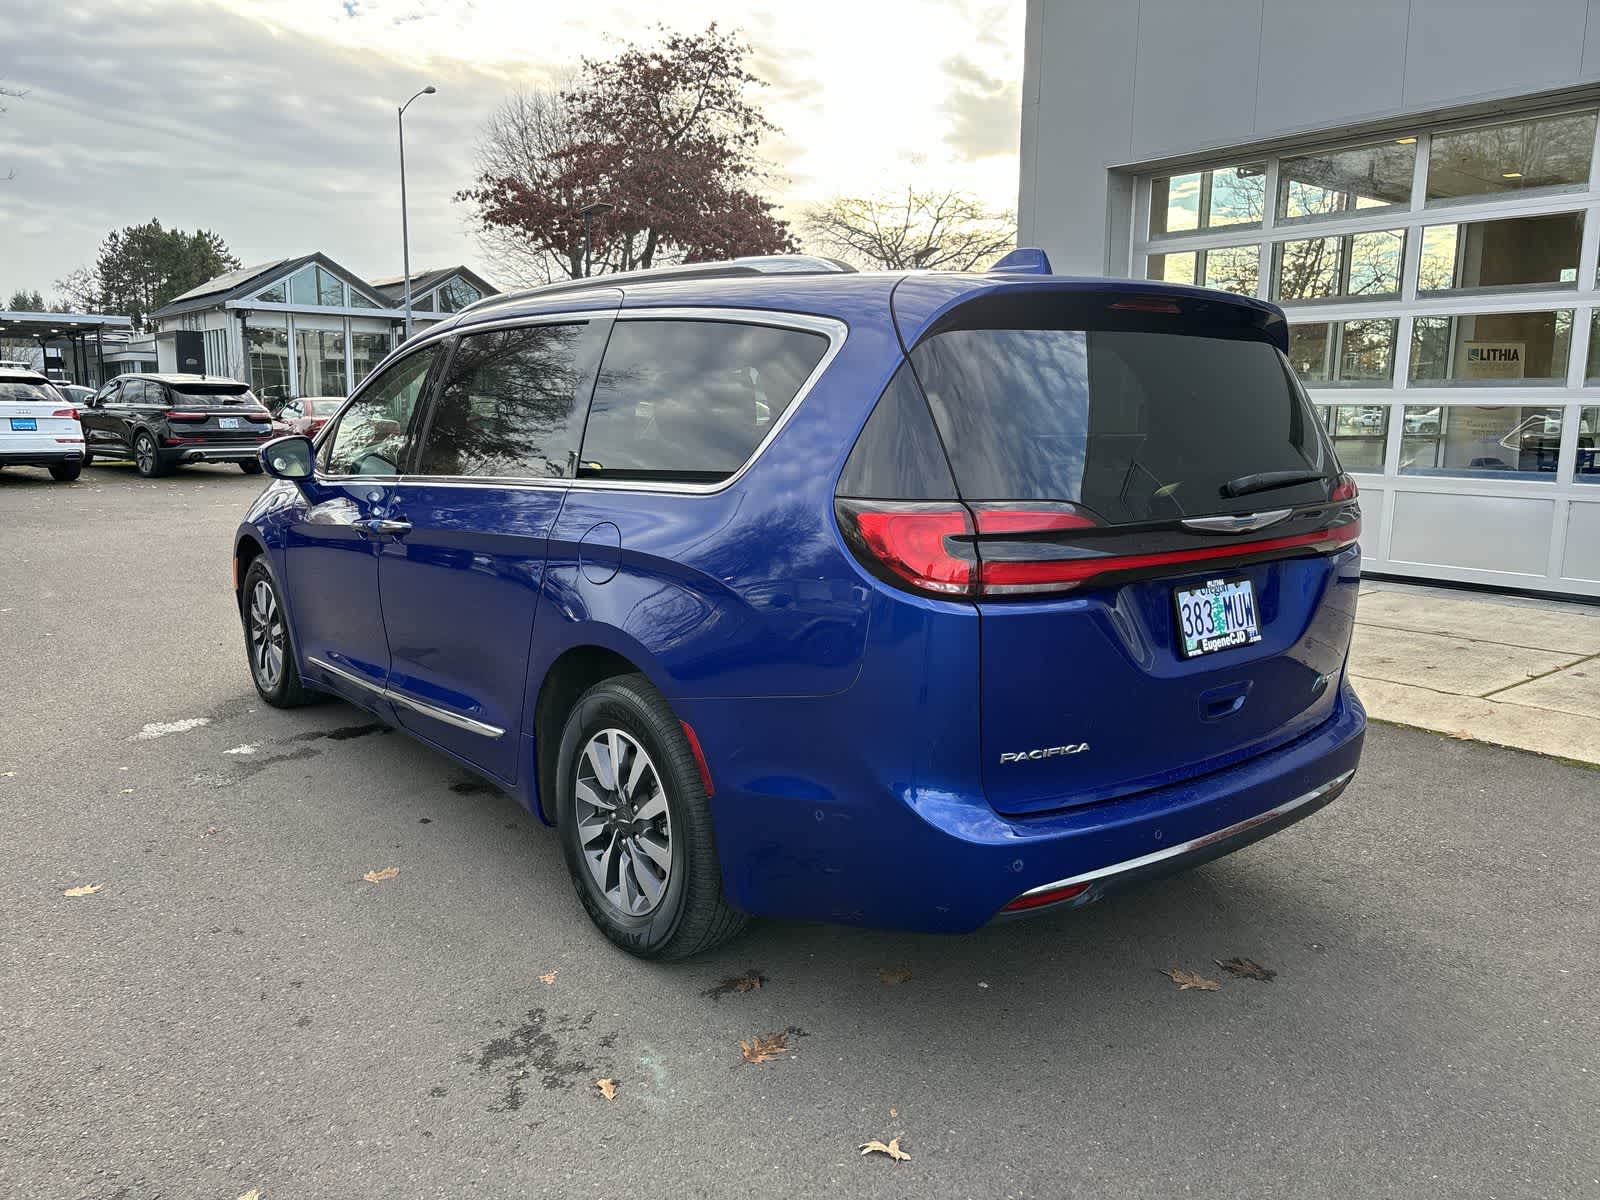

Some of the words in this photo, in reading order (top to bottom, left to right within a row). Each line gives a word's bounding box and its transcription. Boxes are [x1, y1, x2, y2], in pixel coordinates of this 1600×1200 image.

[1480, 348, 1520, 361] LITHIA
[1200, 584, 1229, 596] Oregon
[1182, 600, 1214, 637] 383
[1223, 592, 1255, 630] MUW
[1000, 743, 1090, 764] PACIFICA
